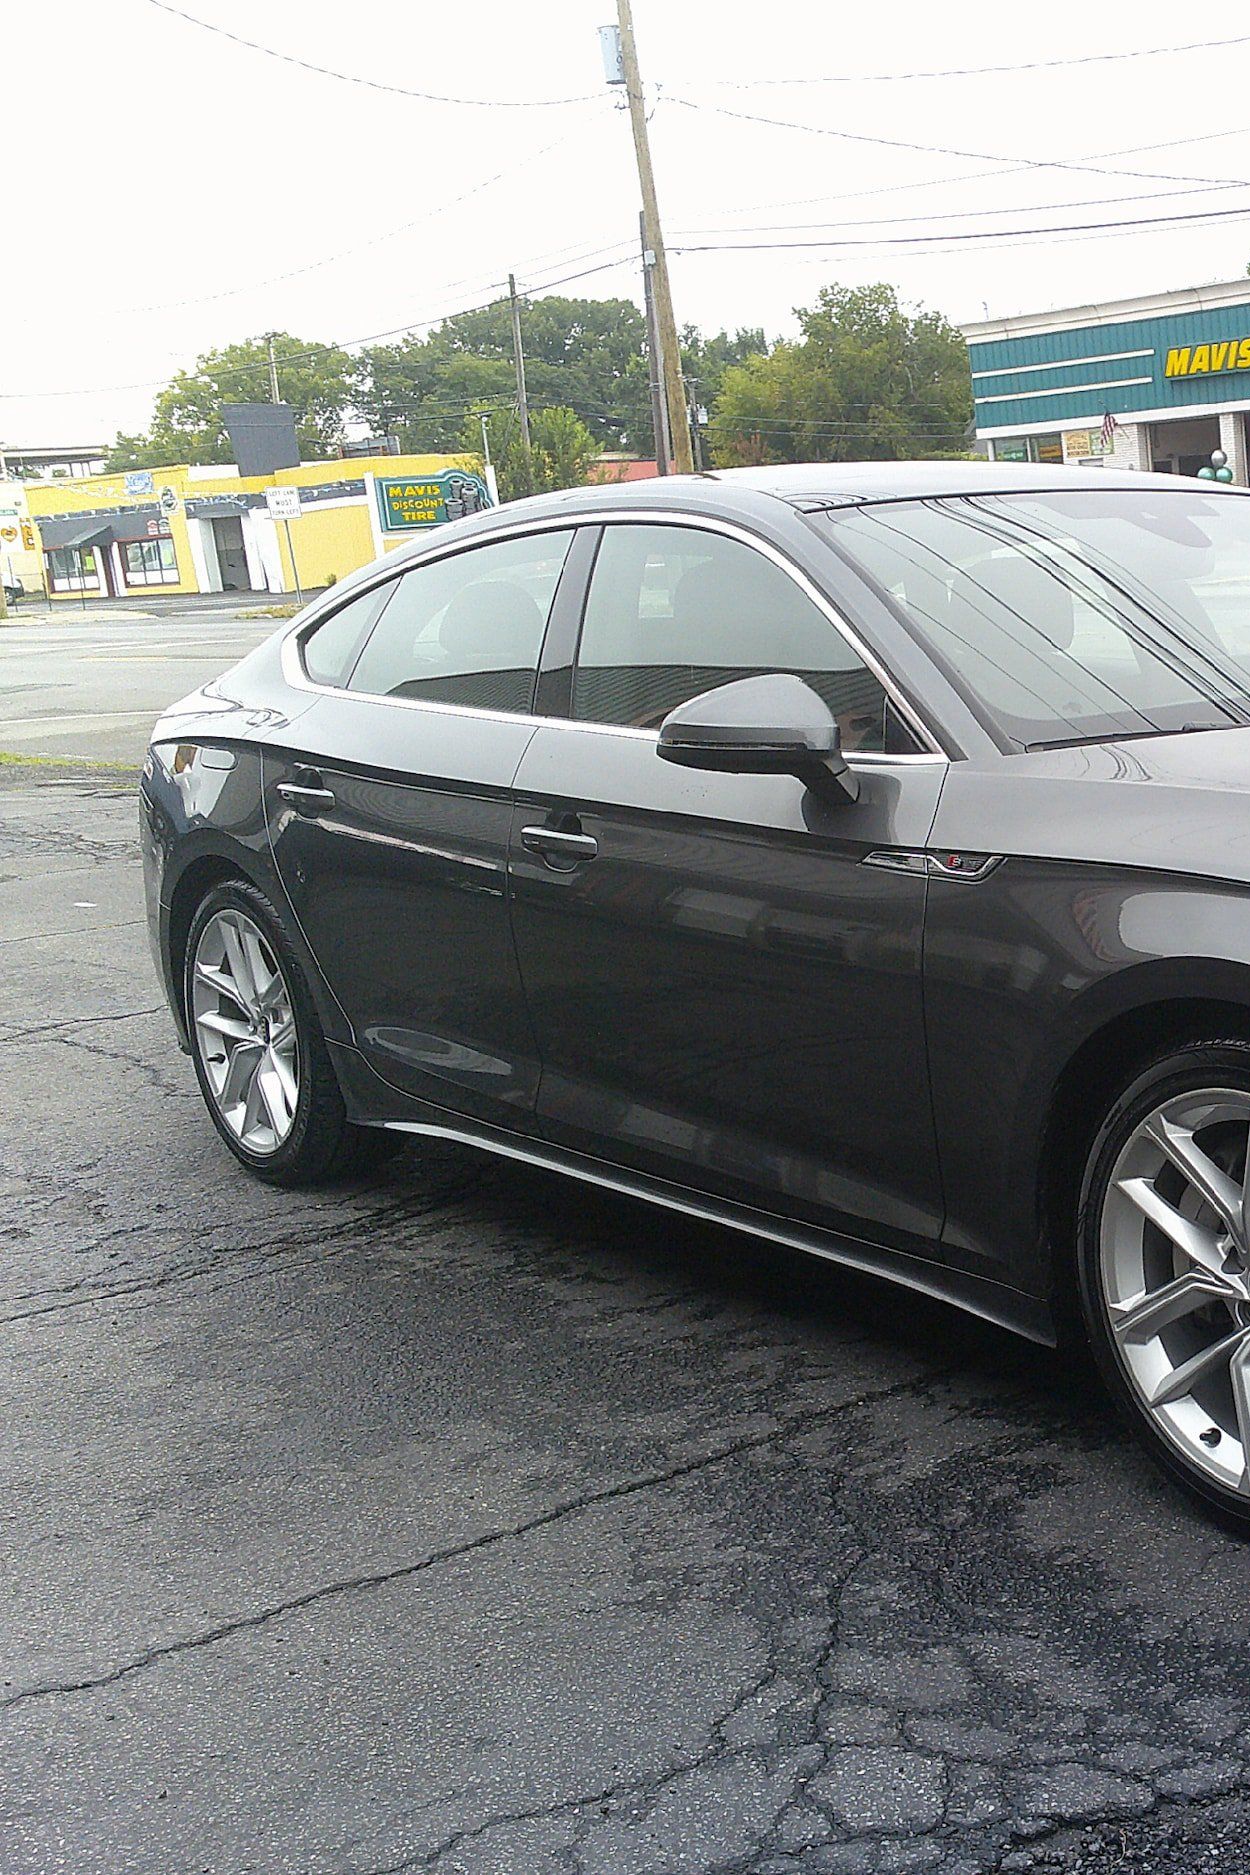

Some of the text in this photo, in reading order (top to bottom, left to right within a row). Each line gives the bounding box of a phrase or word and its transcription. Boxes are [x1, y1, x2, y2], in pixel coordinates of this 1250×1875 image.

[388, 485, 441, 498] MAVIS
[391, 497, 444, 511] DISCOUNT
[402, 510, 436, 521] TIRE
